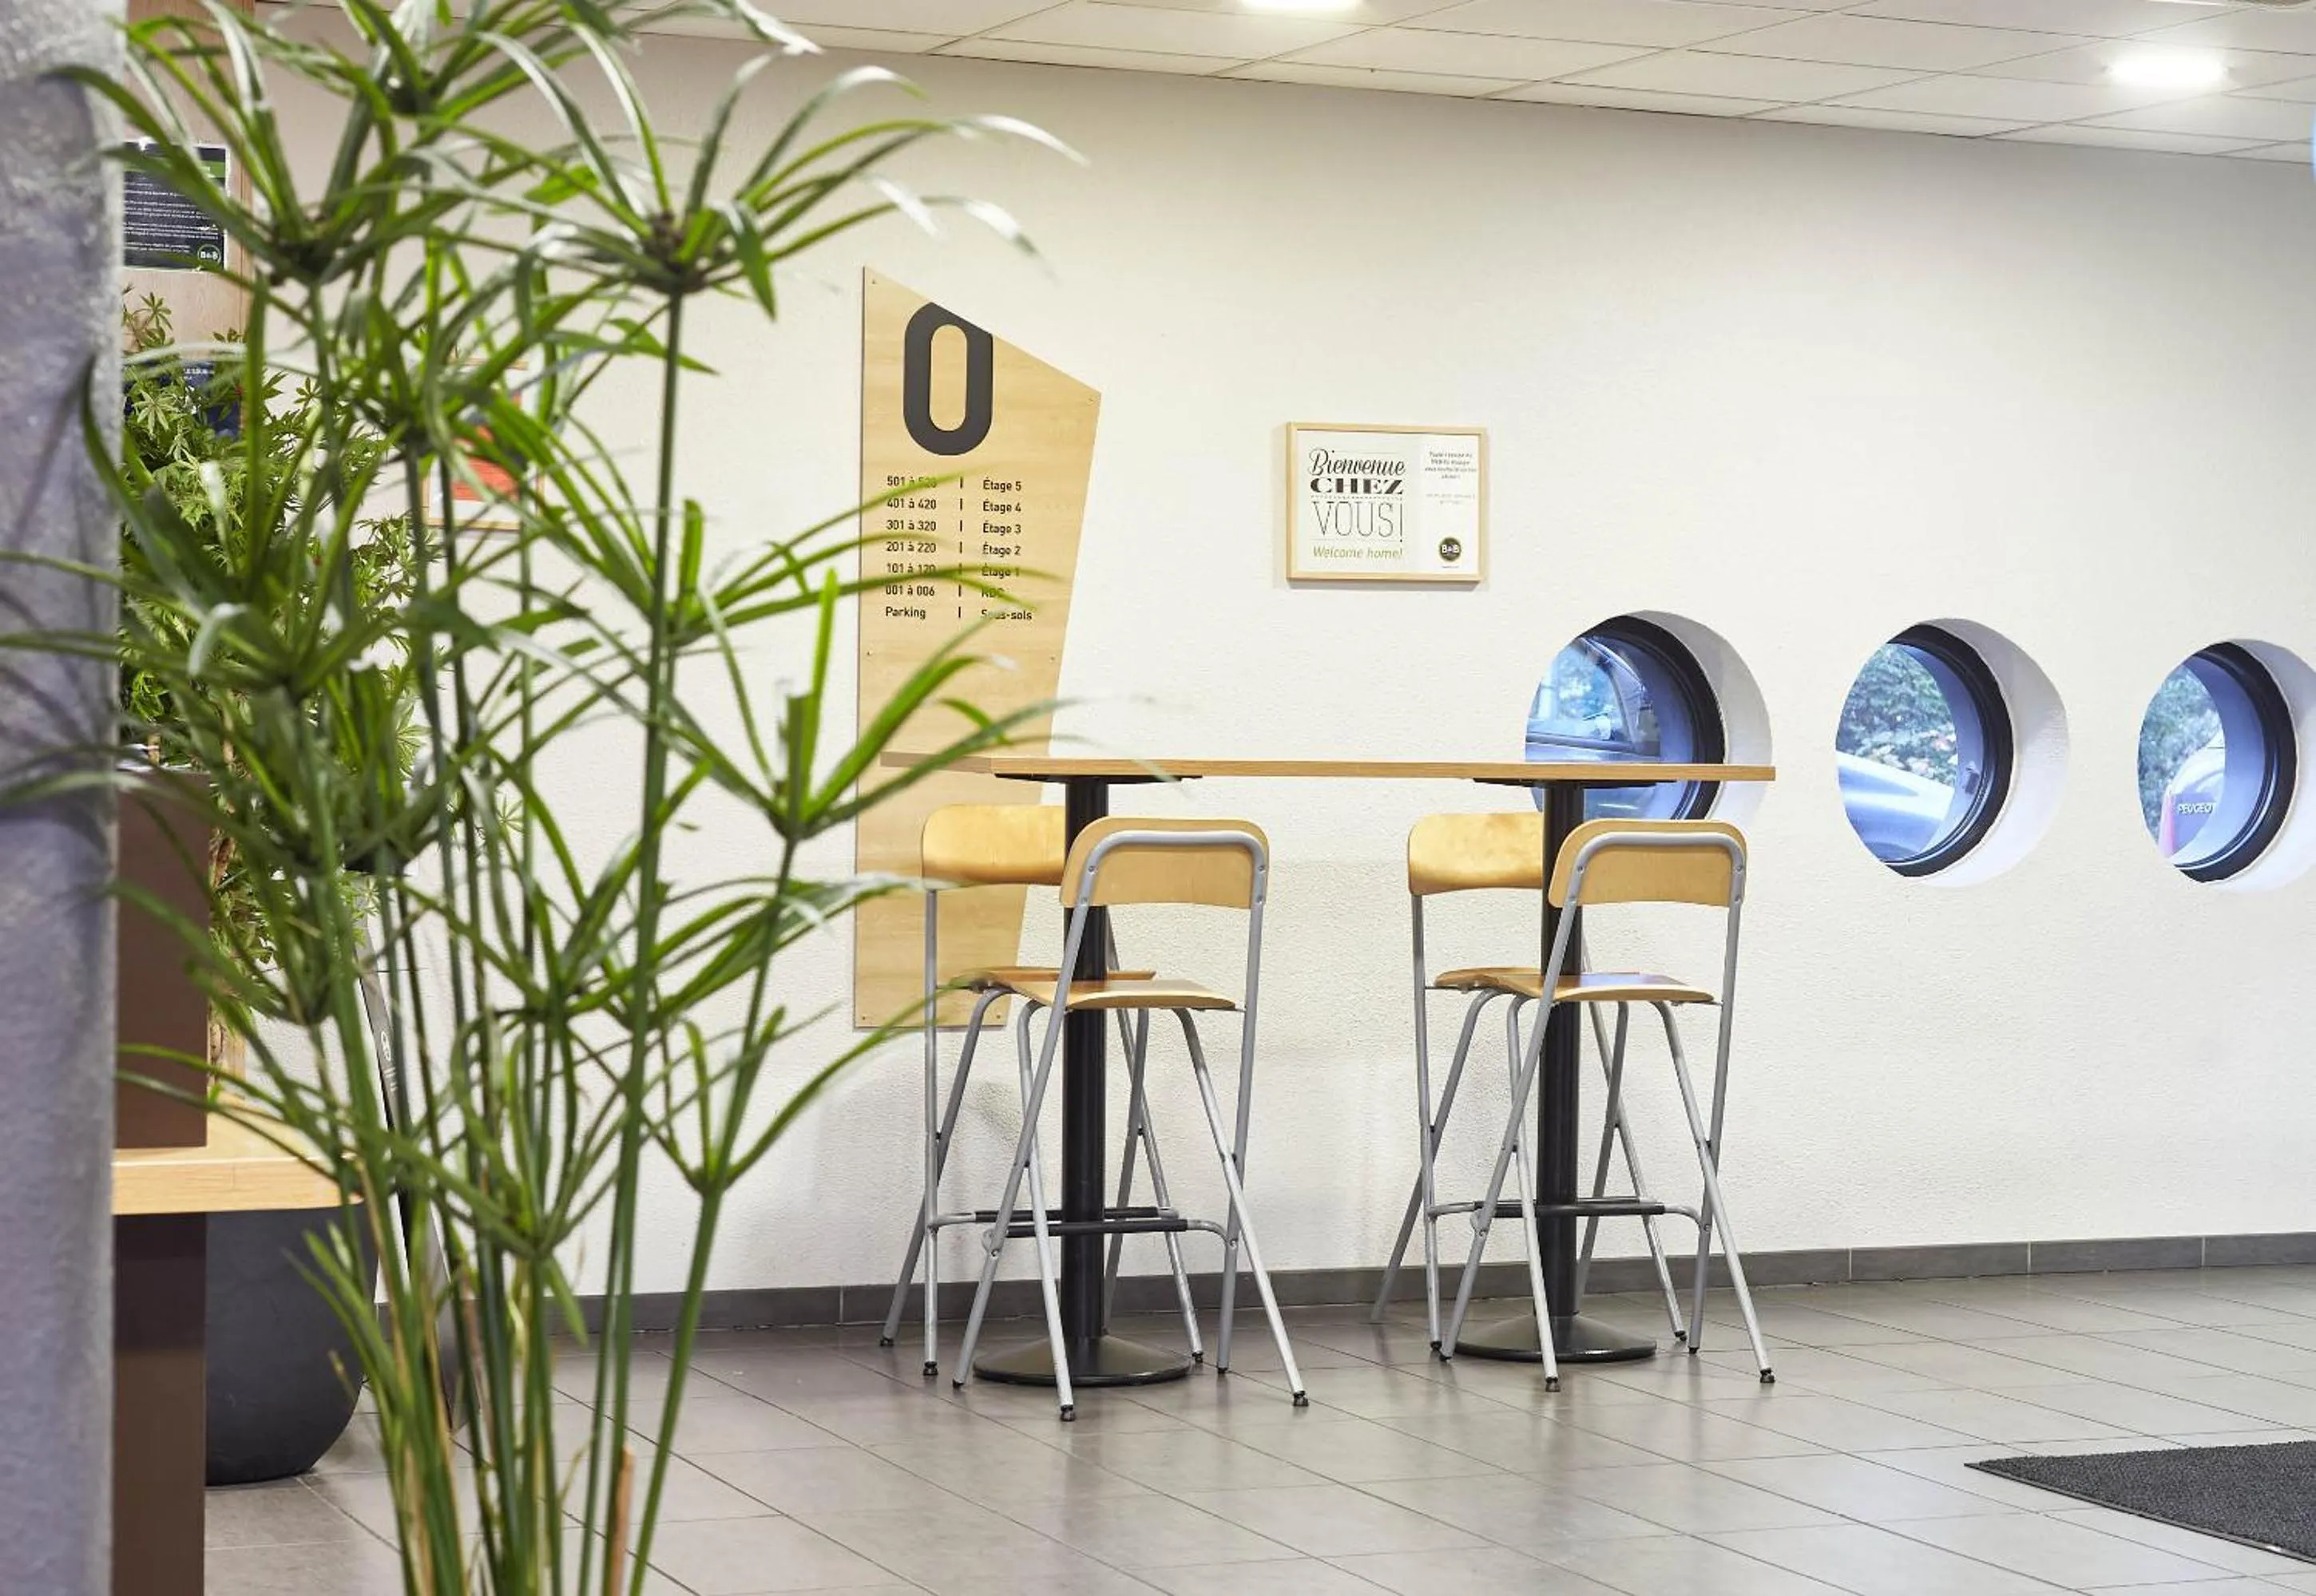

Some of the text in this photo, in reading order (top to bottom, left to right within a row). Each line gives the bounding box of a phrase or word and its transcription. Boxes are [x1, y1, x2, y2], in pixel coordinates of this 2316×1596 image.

[1308, 448, 1406, 477] Bienvenue
[886, 475, 905, 487] 501
[982, 477, 1022, 493] Étage 5
[1310, 477, 1404, 495] CHEZ
[886, 497, 937, 510] 401 à 420
[982, 498, 1022, 514] Étage 4
[886, 519, 937, 532] 301 à 320
[982, 520, 1022, 536] Étage 3
[886, 541, 937, 553] 201 à 220
[982, 542, 1021, 558] Étage 2
[1313, 545, 1403, 560] Welcome home!
[886, 562, 904, 574] 101
[907, 562, 914, 573] à
[982, 562, 1011, 580] Étage
[886, 584, 935, 596] 001 à 006
[886, 605, 926, 620] Parking
[981, 608, 1033, 620] Sus-sols
